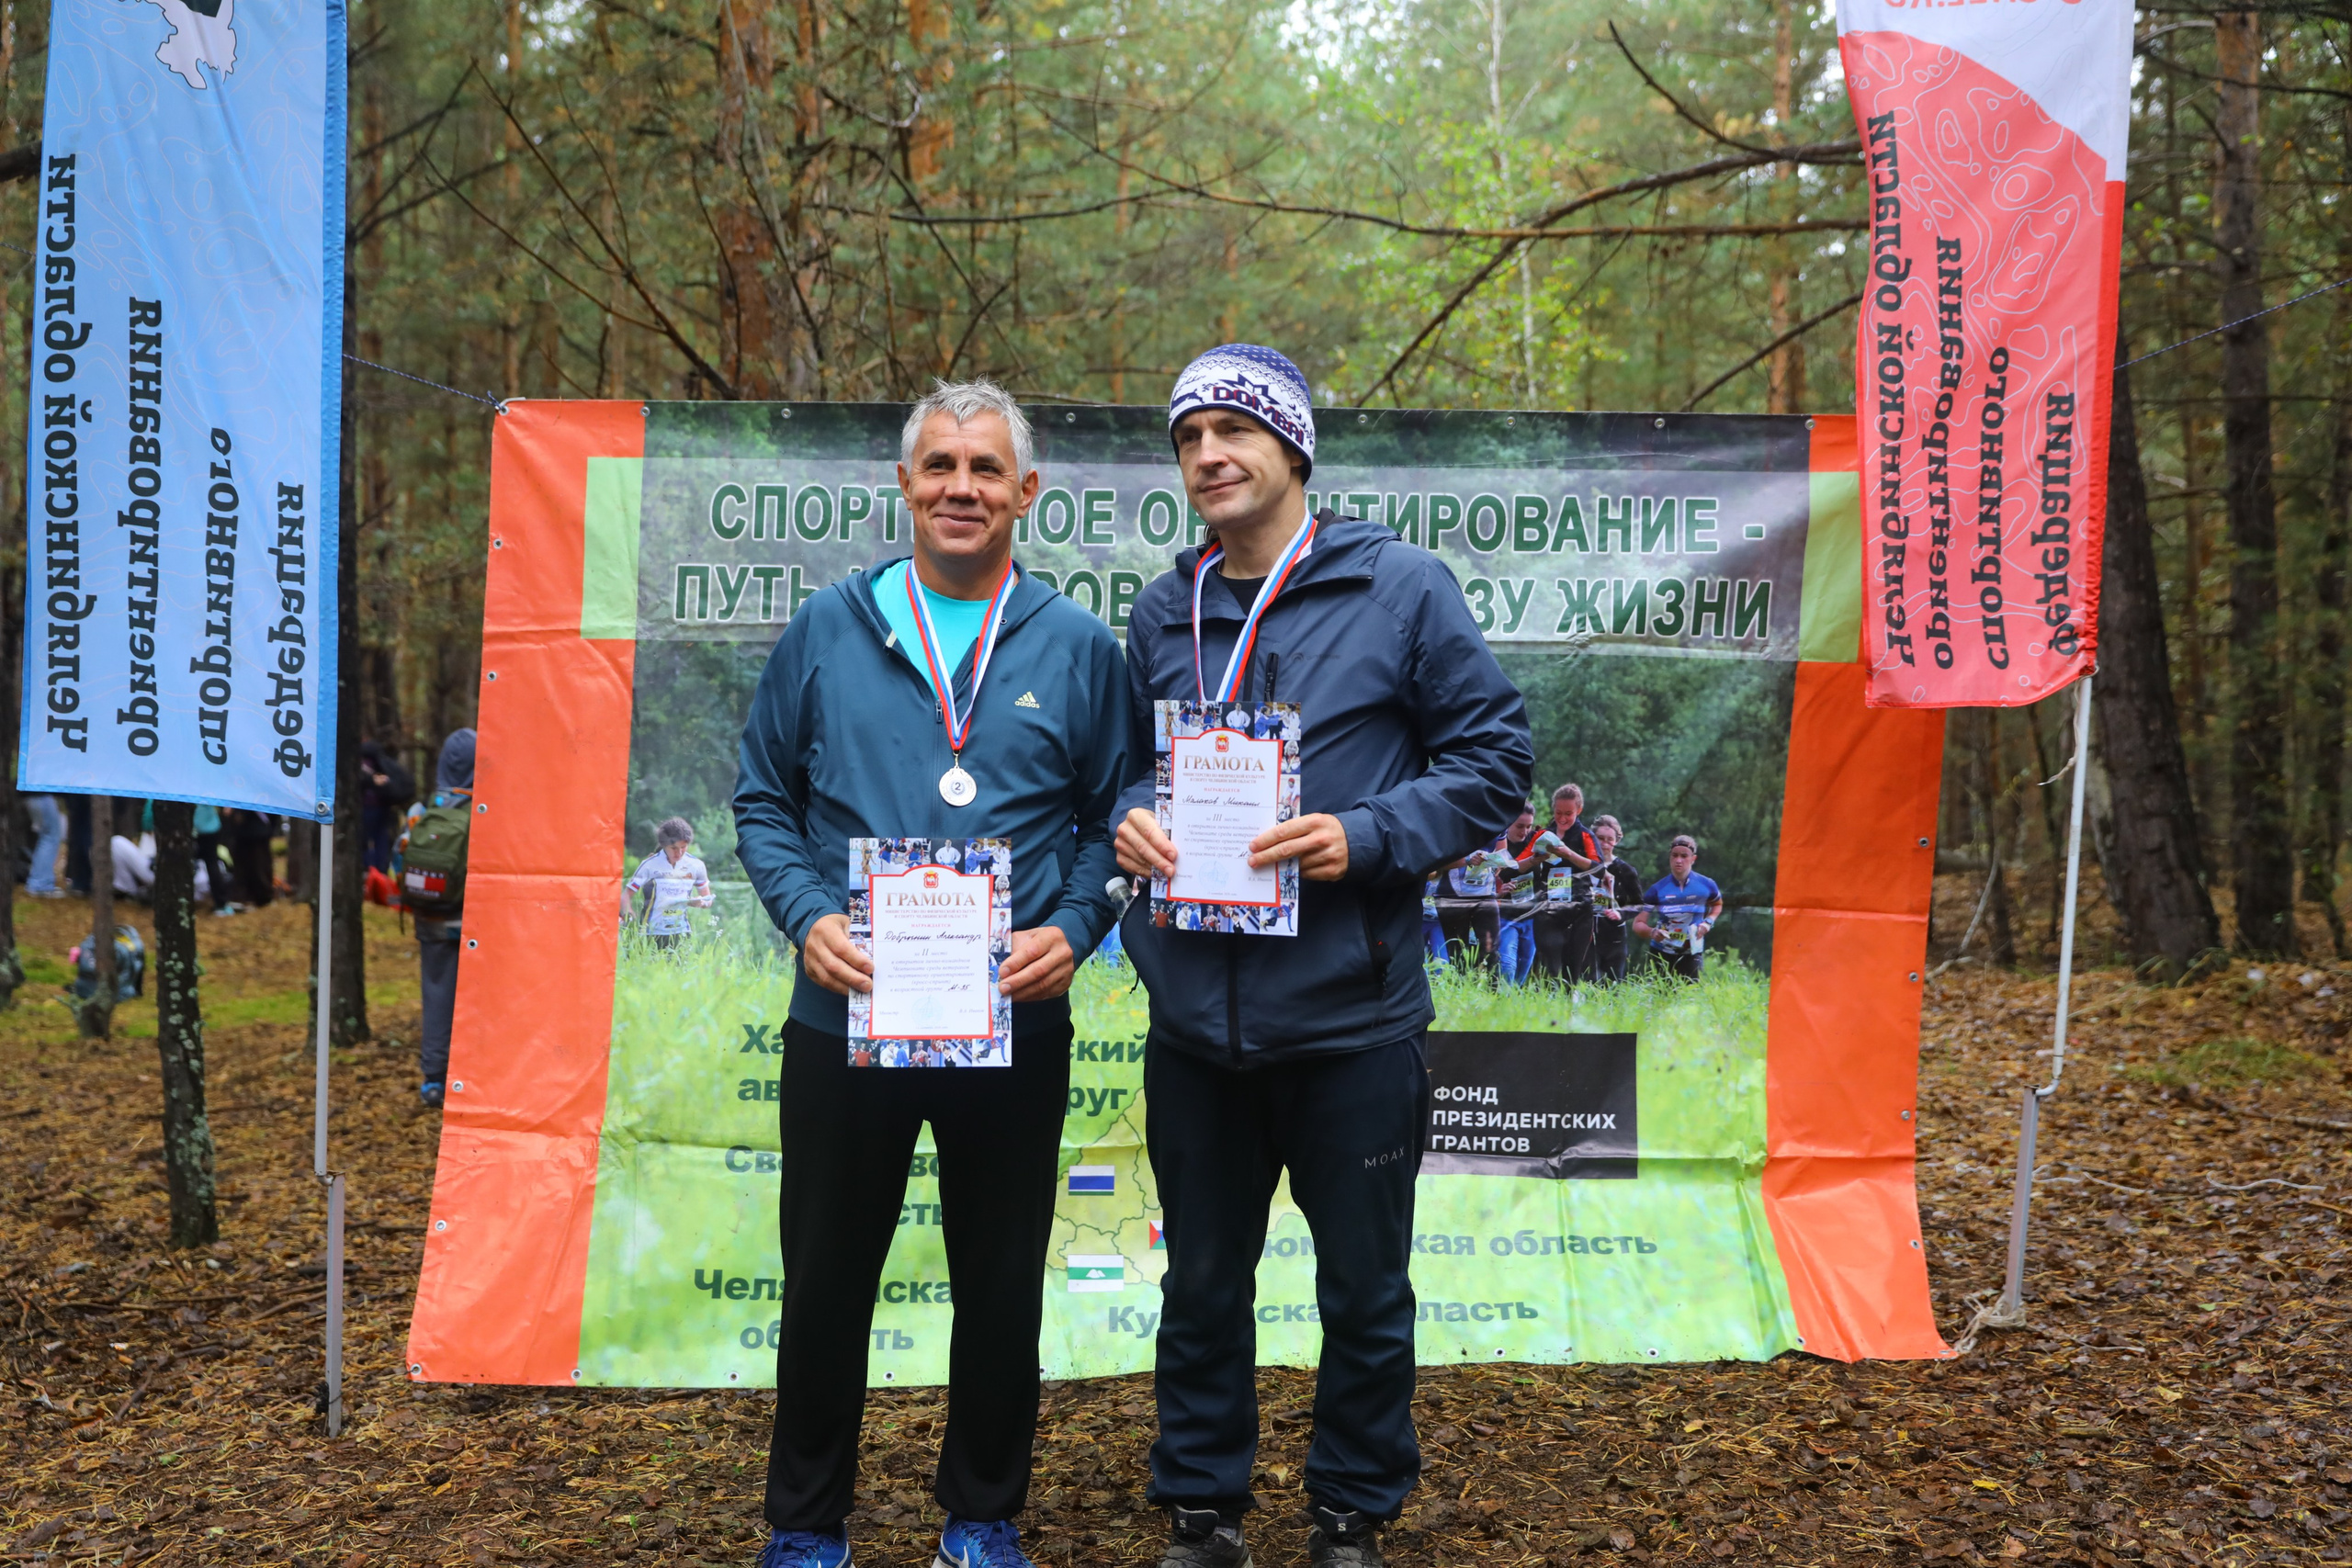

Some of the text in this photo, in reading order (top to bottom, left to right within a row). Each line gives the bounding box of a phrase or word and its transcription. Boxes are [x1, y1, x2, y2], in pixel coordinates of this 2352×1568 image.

[1213, 386, 1304, 446] DOMBAI
[710, 483, 1116, 546] СПОРТОЕ
[1139, 489, 1721, 554] ОТИРОВАНИЕ
[1559, 577, 1773, 640] ЖИЗНИ
[1014, 700, 1040, 709] adidas
[1183, 755, 1264, 772] ГРАМОТА
[955, 782, 961, 791] 2
[886, 892, 976, 906] ГРАМОТА
[1066, 1087, 1127, 1117] руг
[1433, 1086, 1498, 1105] ФОНД
[1432, 1110, 1616, 1131] ПРЕЗИДЕНТСКИХ
[1431, 1134, 1530, 1153] ГРАНТОВ
[1364, 1145, 1405, 1169] MOAX
[1489, 1229, 1657, 1256] область
[1416, 1301, 1539, 1323] ласть
